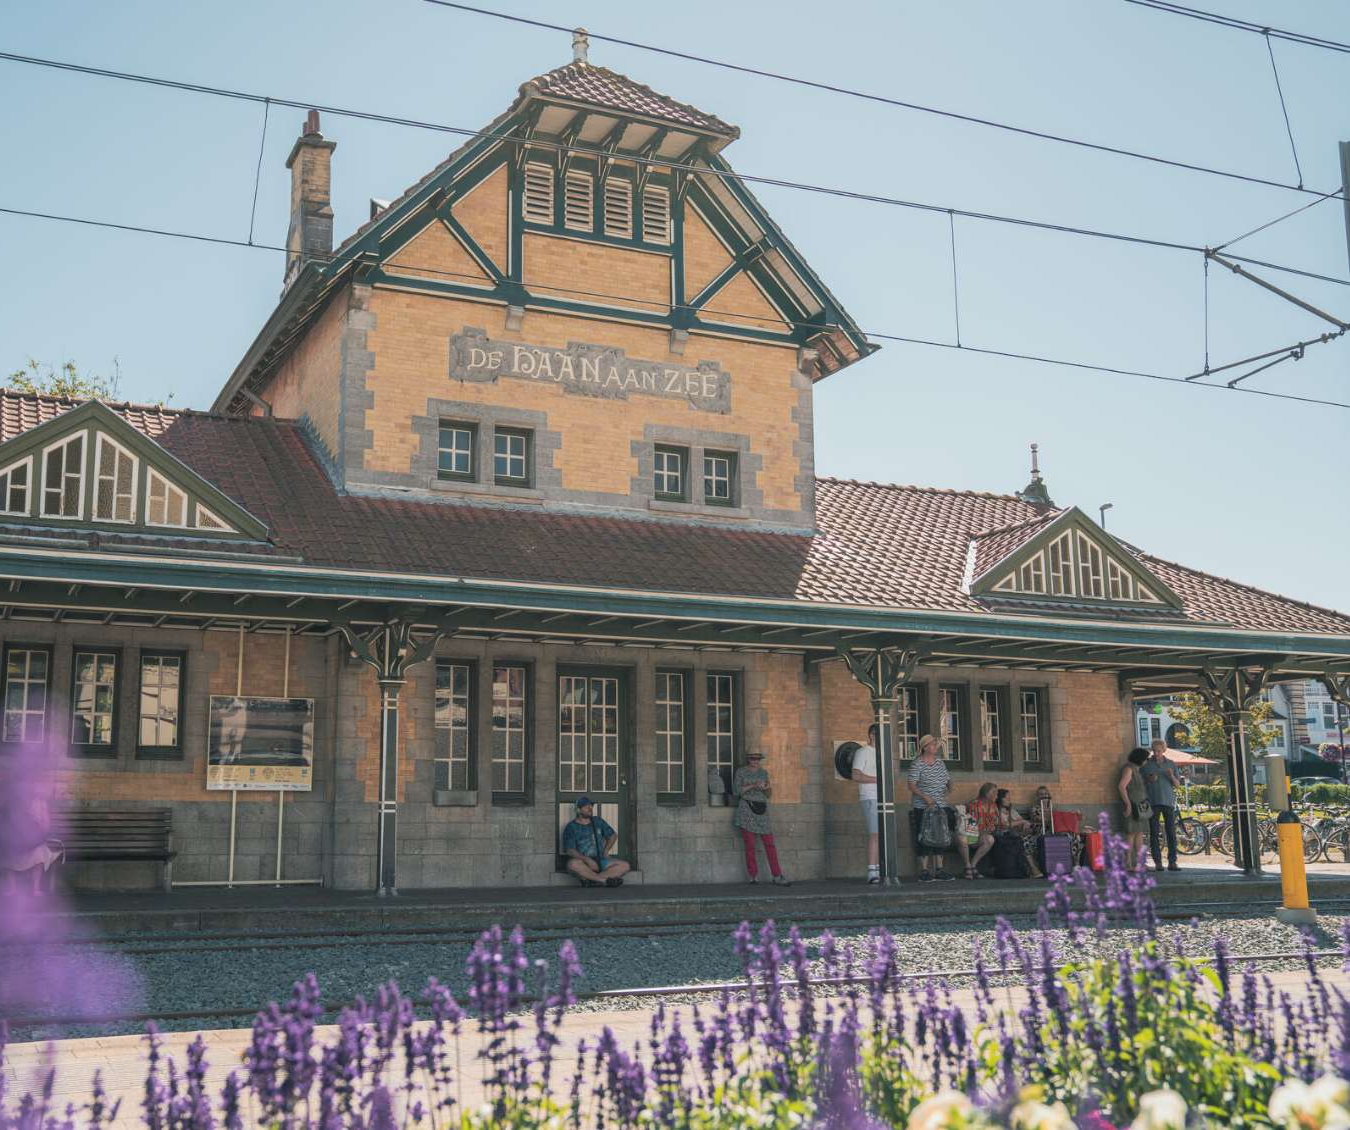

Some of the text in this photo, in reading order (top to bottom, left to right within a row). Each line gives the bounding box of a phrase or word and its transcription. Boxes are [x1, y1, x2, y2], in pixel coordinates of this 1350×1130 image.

[467, 346, 718, 397] DE HAAN AAN ZEE
